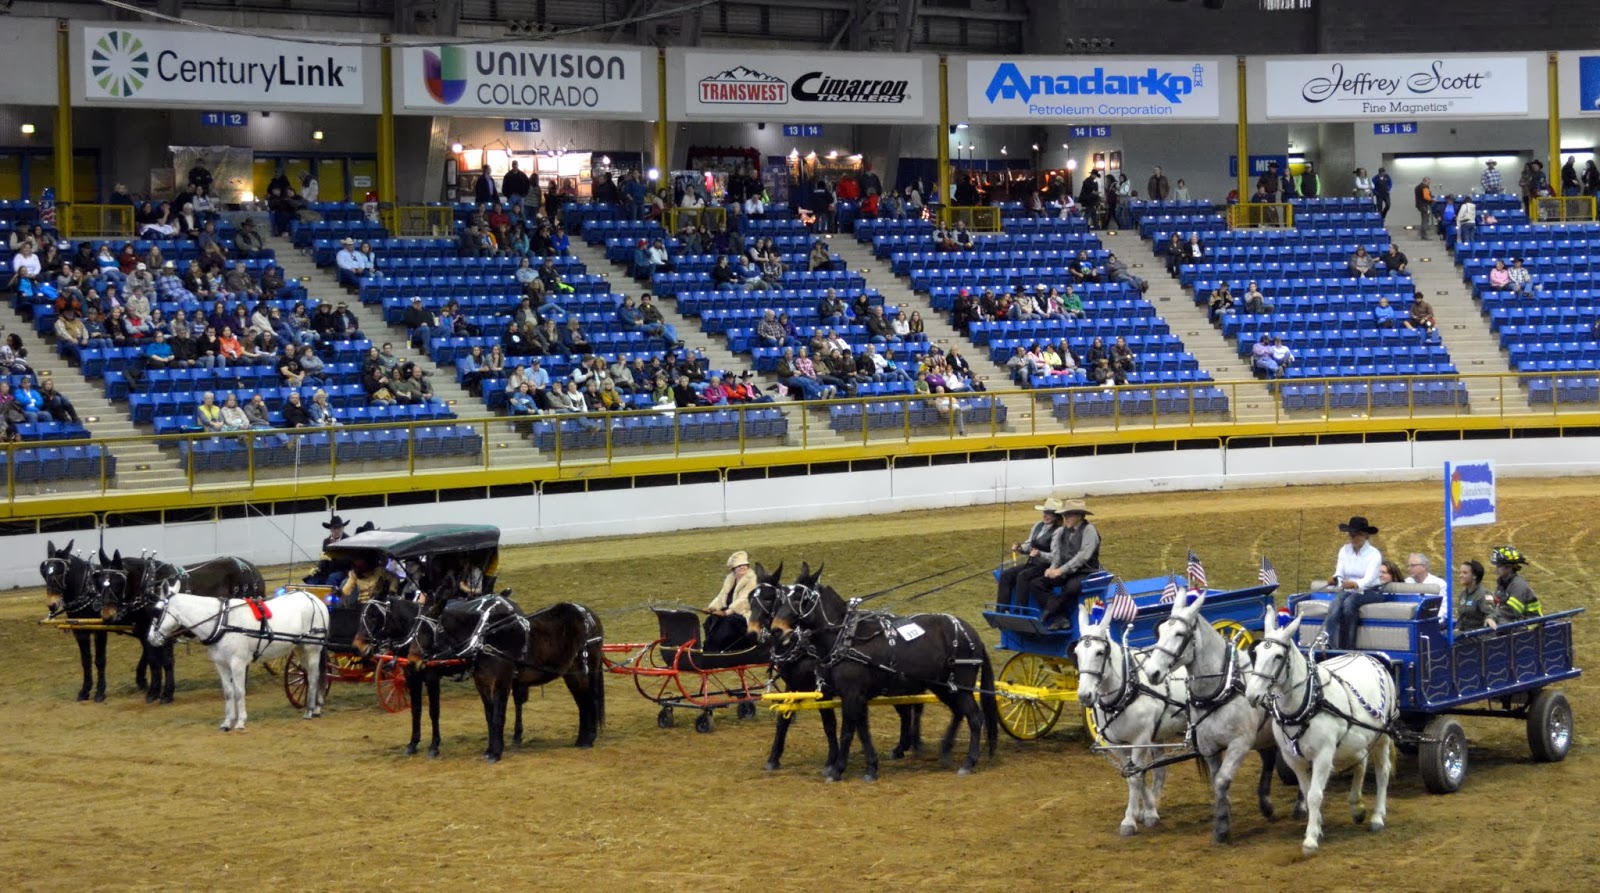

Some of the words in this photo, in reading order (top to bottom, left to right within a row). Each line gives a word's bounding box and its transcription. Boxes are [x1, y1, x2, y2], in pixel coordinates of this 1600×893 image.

[157, 50, 344, 92] CenturyLink
[476, 51, 625, 80] UNIVISION
[791, 71, 909, 102] Cimarron
[985, 62, 1193, 104] Anadarko
[1302, 62, 1400, 103] Jeffrey
[1406, 60, 1484, 94] Scott
[477, 83, 599, 107] COLORADO
[701, 83, 785, 101] TRANSWEST
[817, 94, 901, 102] TRAILERS
[1029, 104, 1095, 115] Petroleum
[1098, 104, 1173, 117] Corporation
[1362, 102, 1387, 113] Fine
[1389, 101, 1448, 114] Magnetics
[208, 114, 218, 124] 11
[230, 114, 241, 125] 12
[510, 121, 520, 131] 12
[529, 122, 539, 132] 13
[788, 126, 799, 135] 13
[809, 126, 818, 135] 14
[1075, 127, 1085, 136] 14
[1096, 127, 1106, 136] 15
[1380, 124, 1390, 133] 15
[1402, 123, 1412, 133] 16
[1255, 159, 1277, 172] ME
